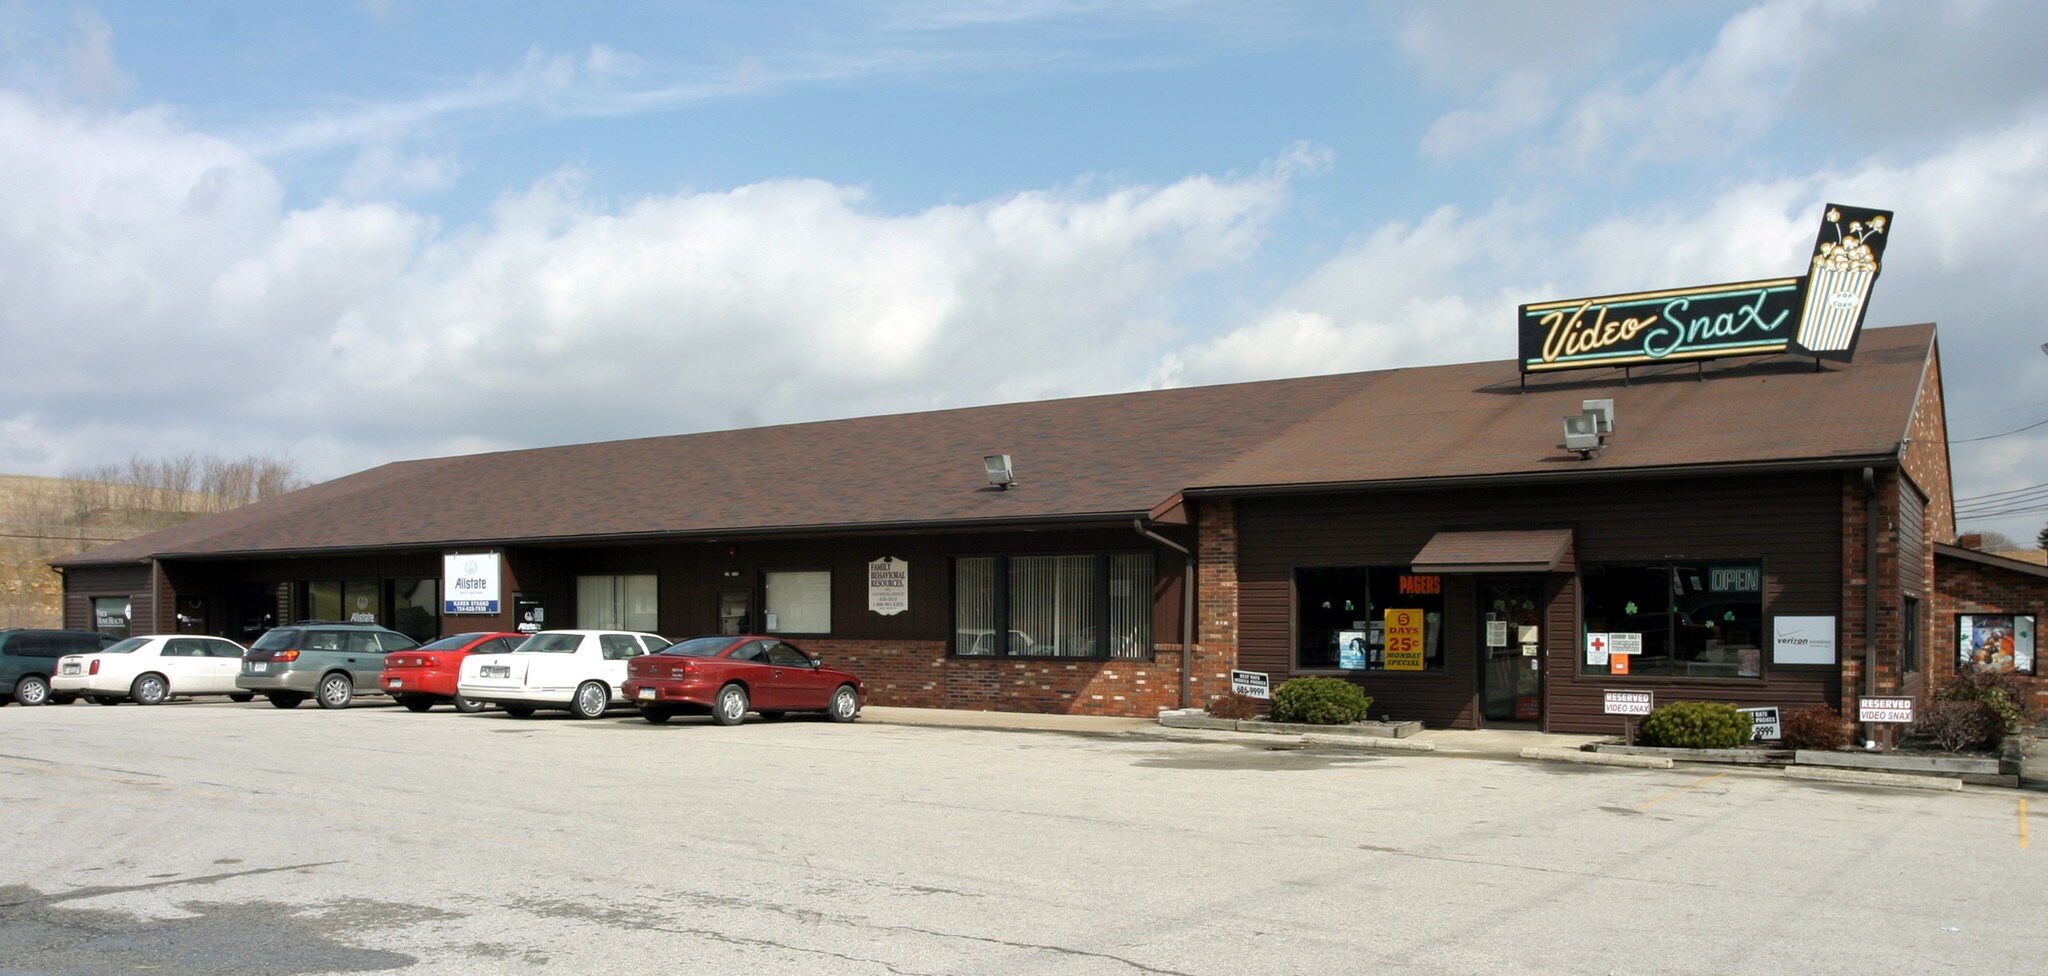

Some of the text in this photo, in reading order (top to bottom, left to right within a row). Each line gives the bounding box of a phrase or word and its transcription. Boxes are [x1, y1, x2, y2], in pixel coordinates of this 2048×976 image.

[1540, 289, 1789, 362] Video Snax
[870, 563, 891, 571] FAMILY
[870, 571, 906, 579] BEHAVIORAL
[454, 577, 487, 590] Allstate
[1399, 575, 1441, 594] PAGERS
[1711, 569, 1759, 591] OPEN
[1777, 637, 1809, 645] verizon
[1606, 693, 1649, 702] RESERVED
[1861, 699, 1911, 708] RESERVED
[1606, 704, 1650, 713] VIDEO SNAX
[1861, 710, 1911, 720] VIDEO SNAX
